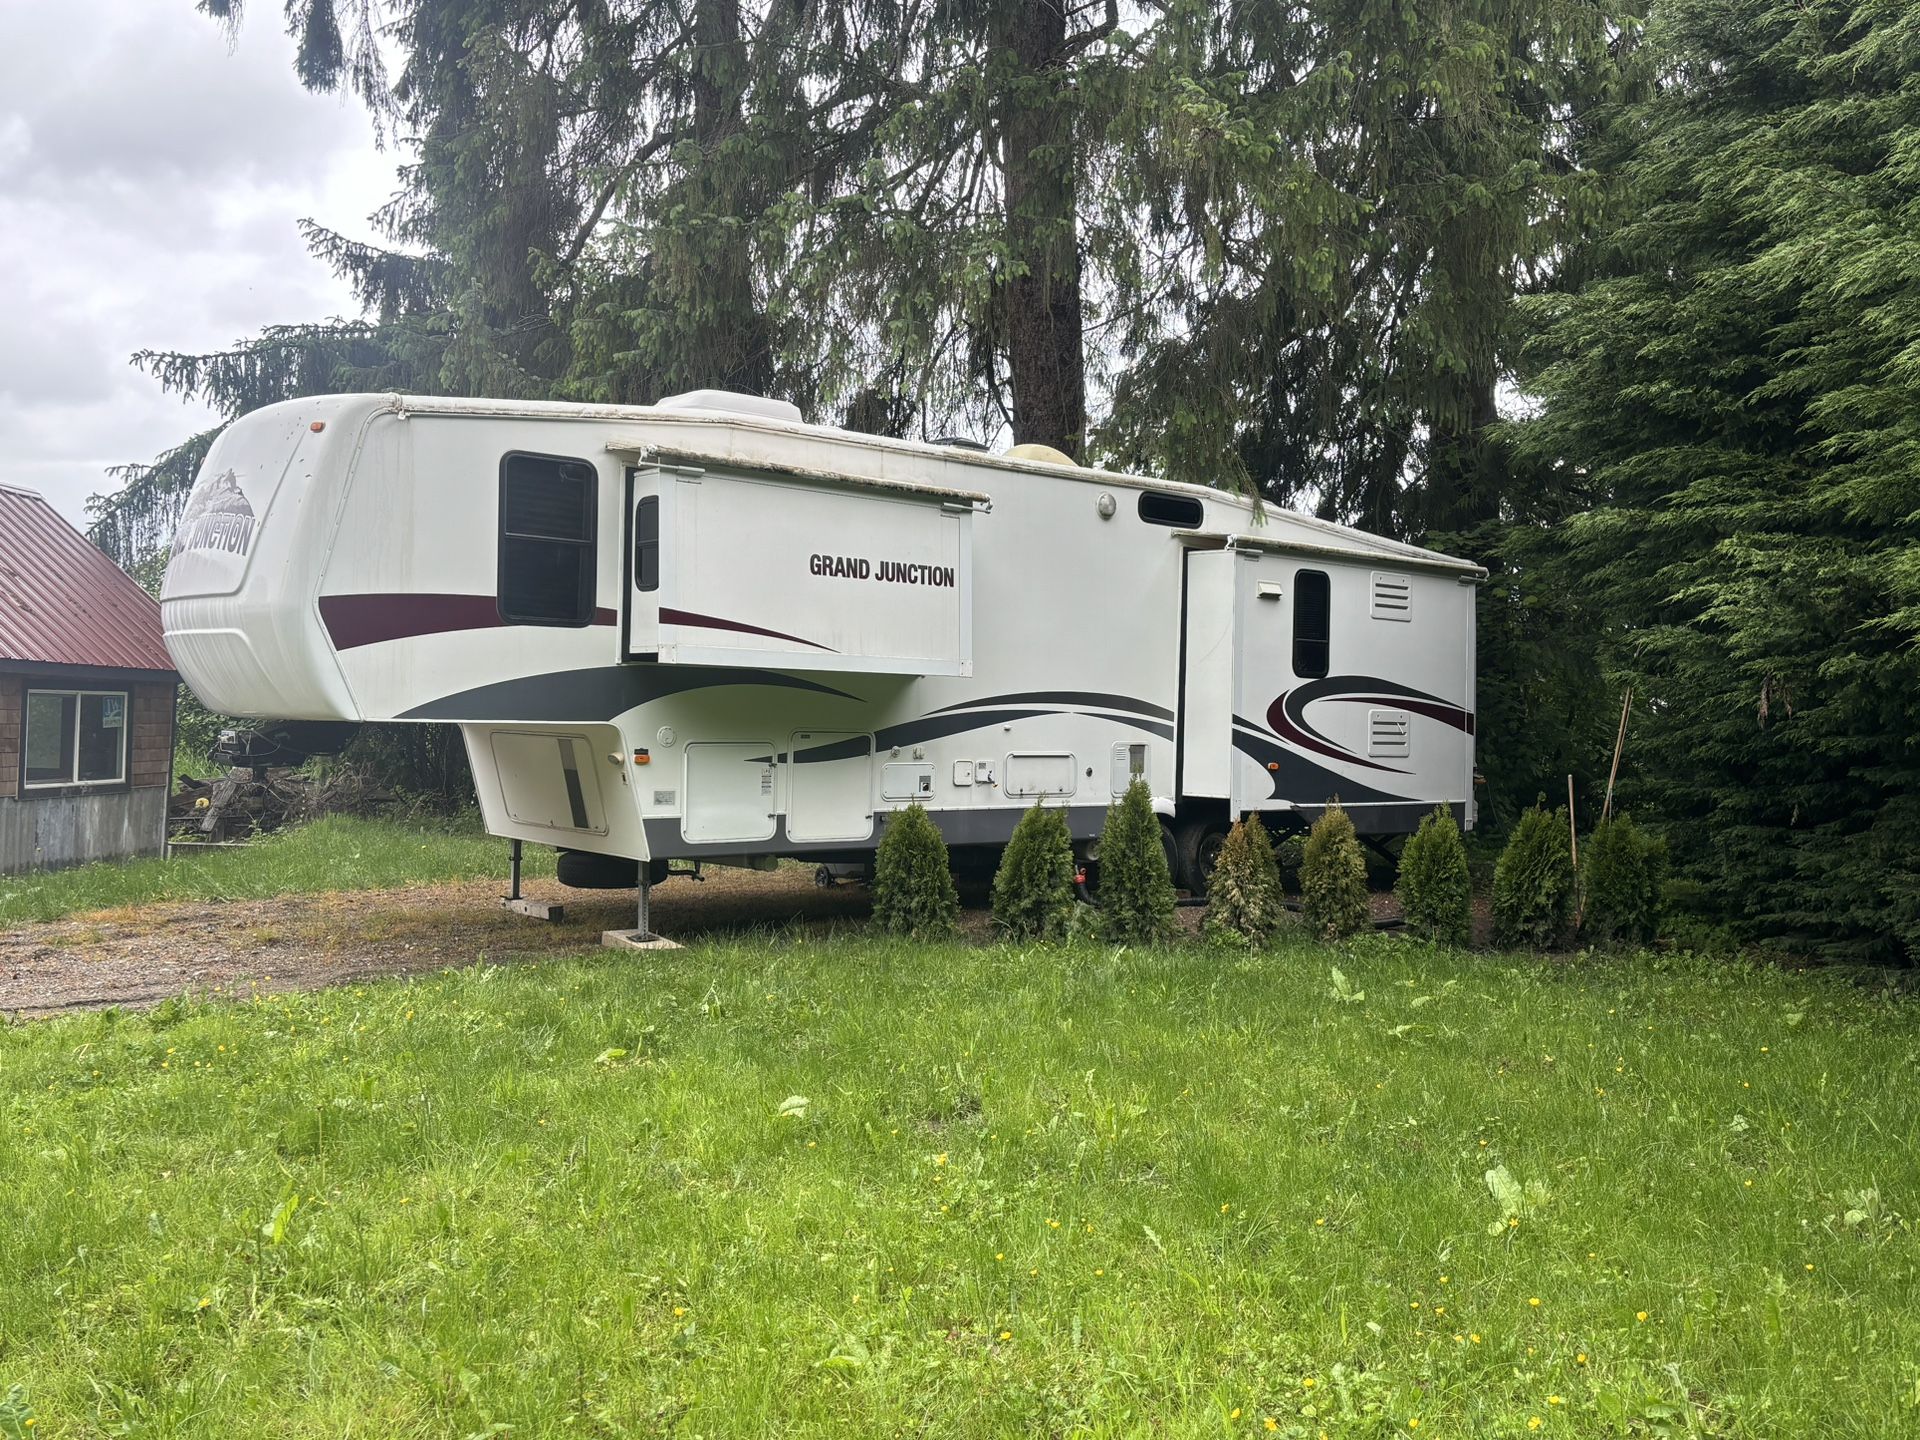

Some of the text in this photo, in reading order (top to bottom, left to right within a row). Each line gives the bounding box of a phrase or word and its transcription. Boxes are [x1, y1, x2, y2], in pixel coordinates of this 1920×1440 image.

[186, 511, 256, 557] JUNCTION
[810, 554, 955, 588] GRAND JUNCTION
